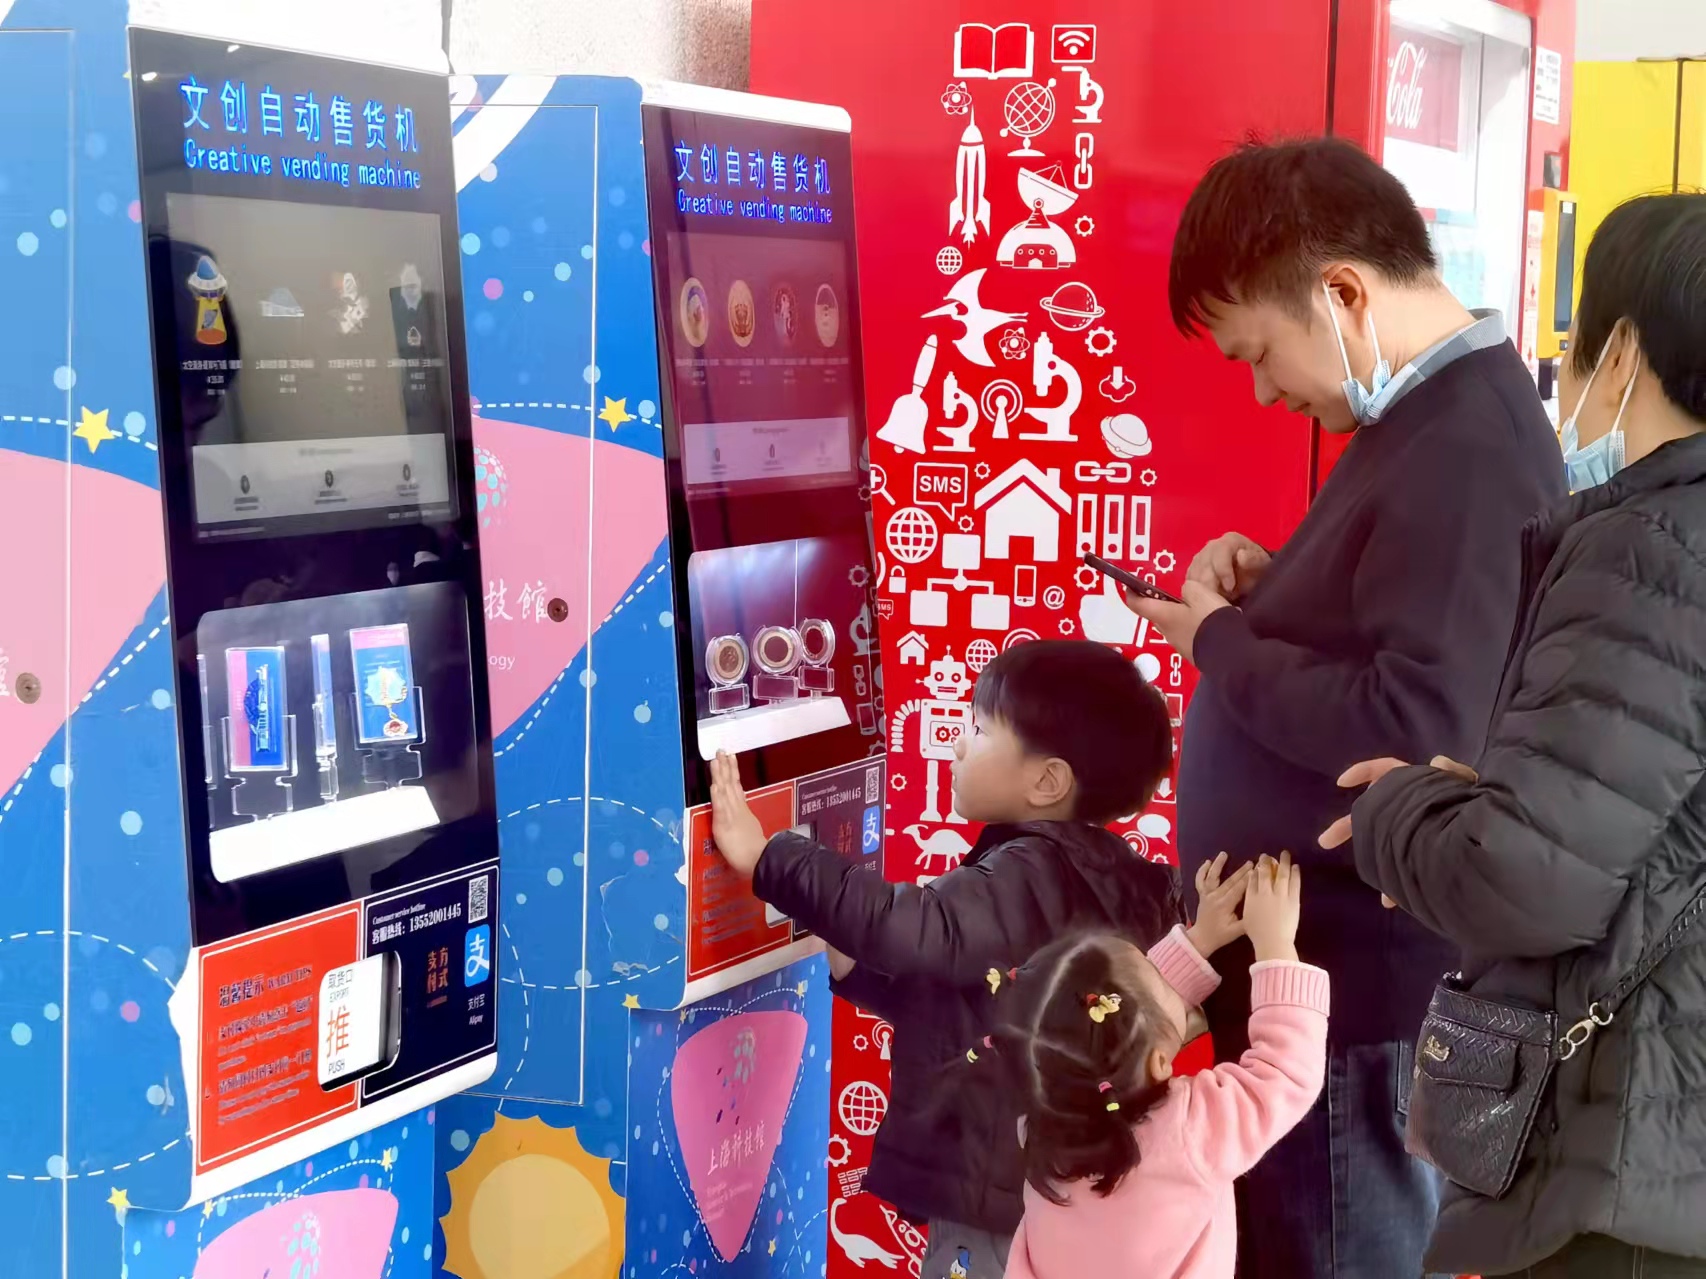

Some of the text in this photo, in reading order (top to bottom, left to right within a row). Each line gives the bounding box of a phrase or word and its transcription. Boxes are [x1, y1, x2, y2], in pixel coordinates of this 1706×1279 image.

[180, 76, 418, 152] 文创自动售货机
[184, 138, 421, 190] Creative vending machine
[674, 140, 831, 194] 文创自动售货机
[678, 188, 833, 224] Creative vending machine
[919, 475, 962, 494] SMS
[489, 655, 516, 670] ogy
[409, 902, 462, 932] 13552001445
[326, 1005, 350, 1060] 推
[328, 1058, 346, 1076] PUSH
